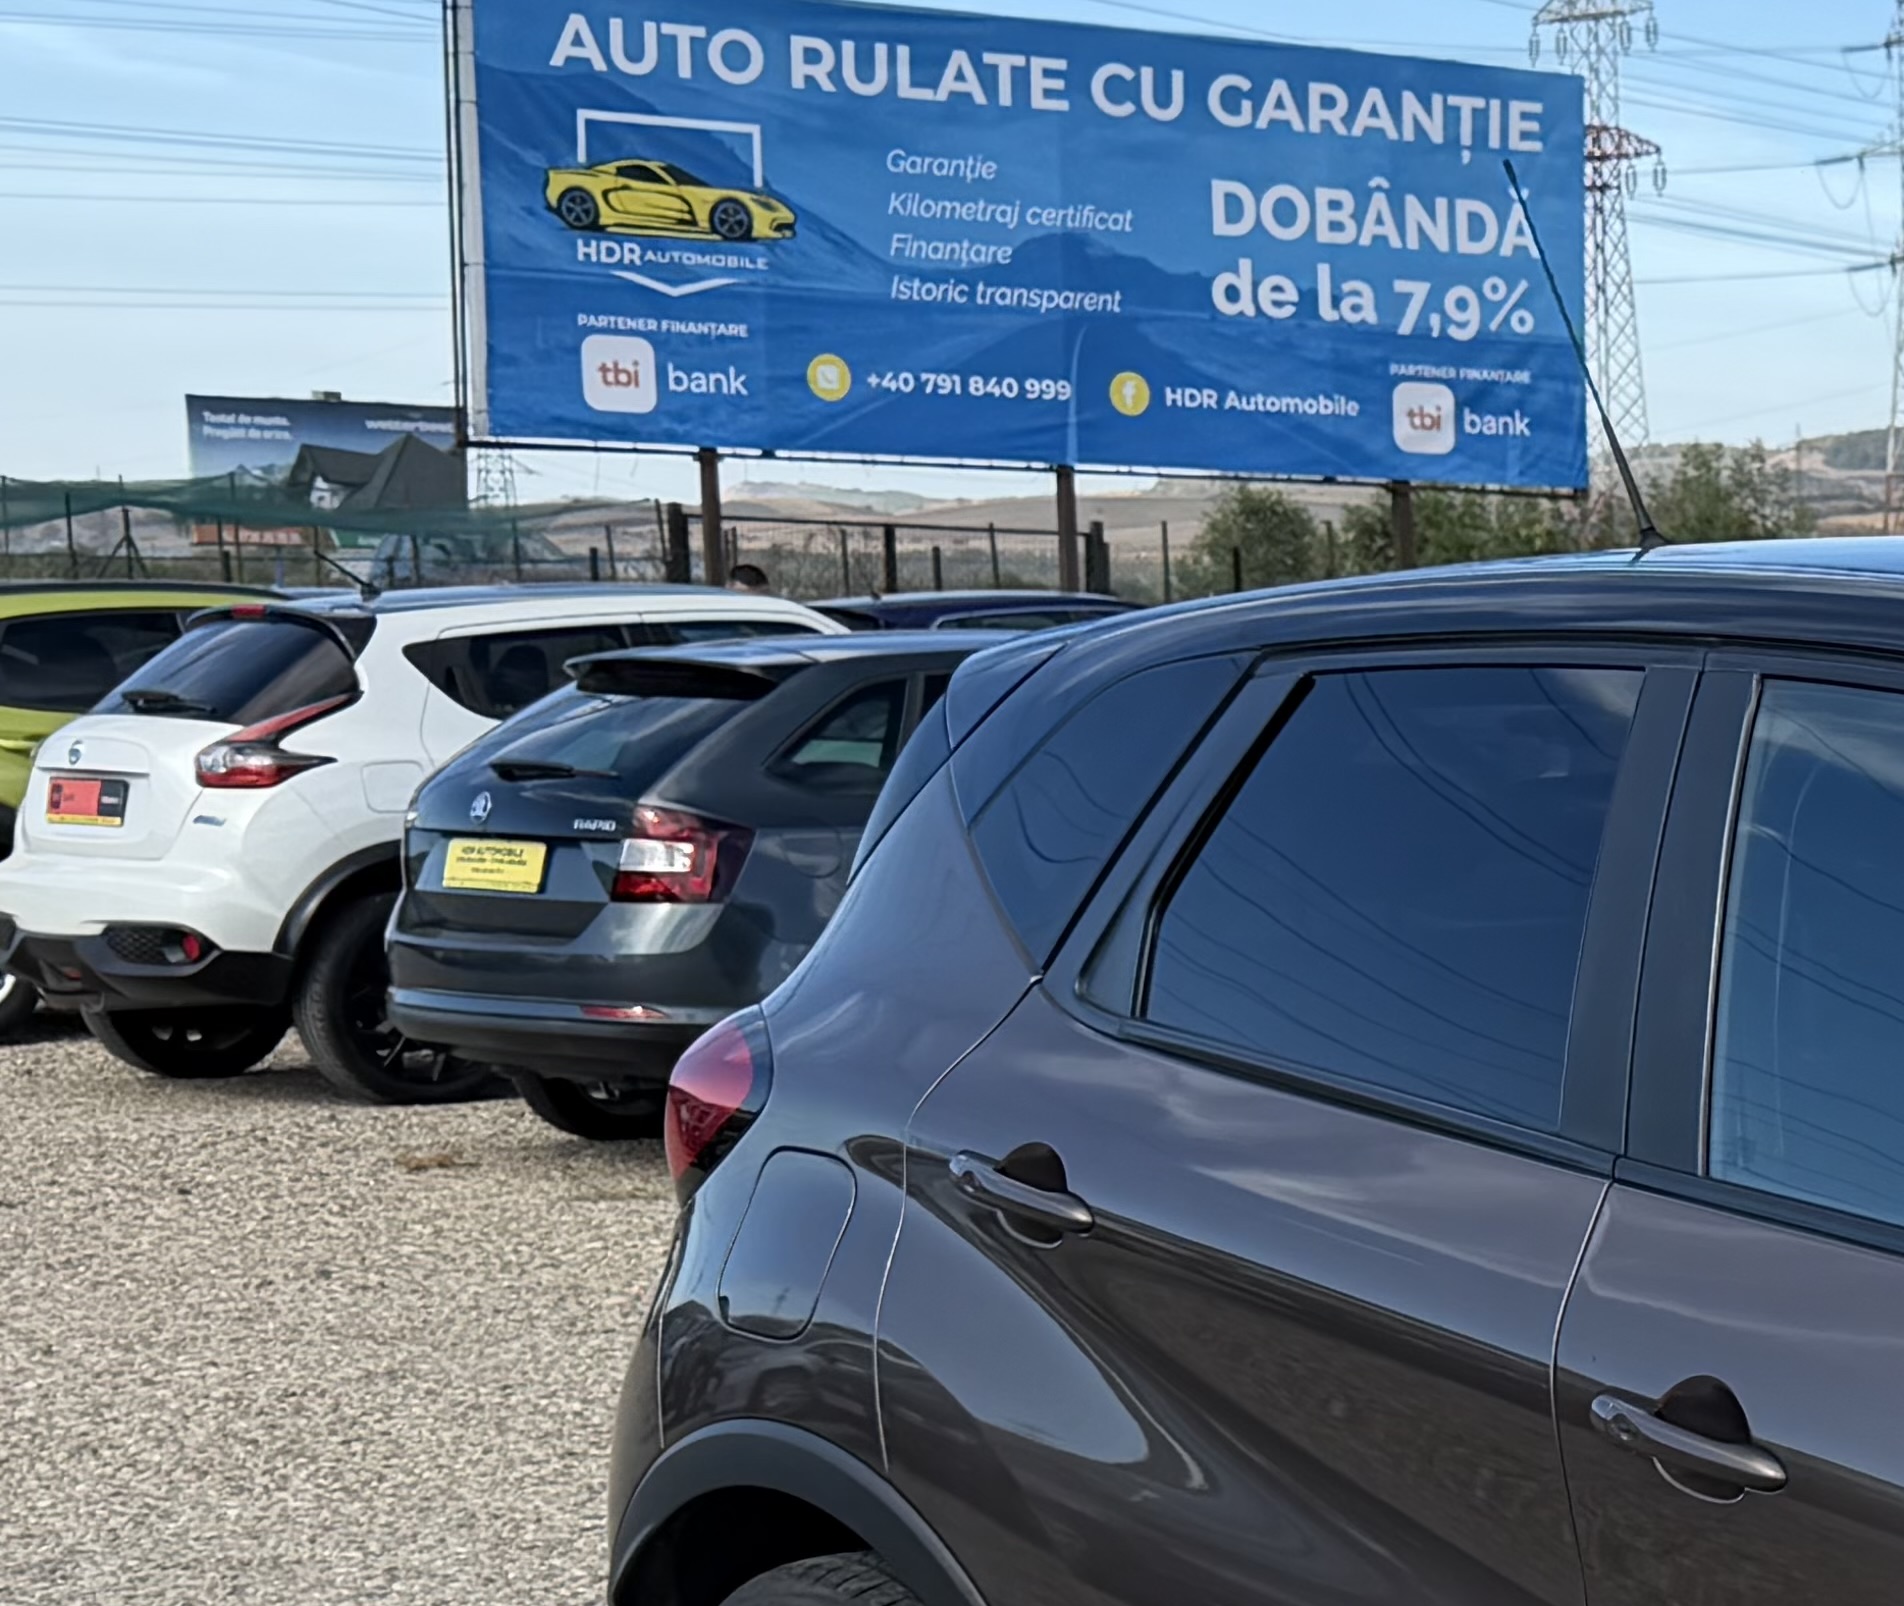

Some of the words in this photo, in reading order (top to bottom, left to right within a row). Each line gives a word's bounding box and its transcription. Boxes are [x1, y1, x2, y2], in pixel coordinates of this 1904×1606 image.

[549, 13, 764, 85] AUTO
[790, 35, 1069, 112] RULATE
[1090, 62, 1184, 122] CU
[1207, 74, 1543, 164] GARANȚIE
[886, 149, 997, 183] Garanție
[888, 192, 1020, 229] Kilometraj
[1026, 205, 1133, 232] certificat
[1211, 176, 1541, 259] DOBÂNDĂ
[576, 239, 642, 266] HDR
[643, 249, 769, 270] AUTOMOBILE
[890, 233, 1013, 267] Finanțare
[891, 275, 969, 304] Istoric
[976, 282, 1122, 313] transparent
[1211, 258, 1299, 319] de
[1317, 263, 1378, 325] la
[1393, 276, 1535, 341] 7,9%
[577, 314, 658, 332] PARTENER
[598, 360, 640, 388] tbi
[667, 362, 748, 395] bank
[867, 371, 915, 393] +40
[920, 373, 961, 395] 791
[968, 376, 1018, 398] 840
[1024, 379, 1072, 400] 999
[1165, 386, 1218, 409] HDR
[1224, 390, 1360, 416] Automobile
[1407, 405, 1441, 431] tbi
[1463, 406, 1531, 436] bank
